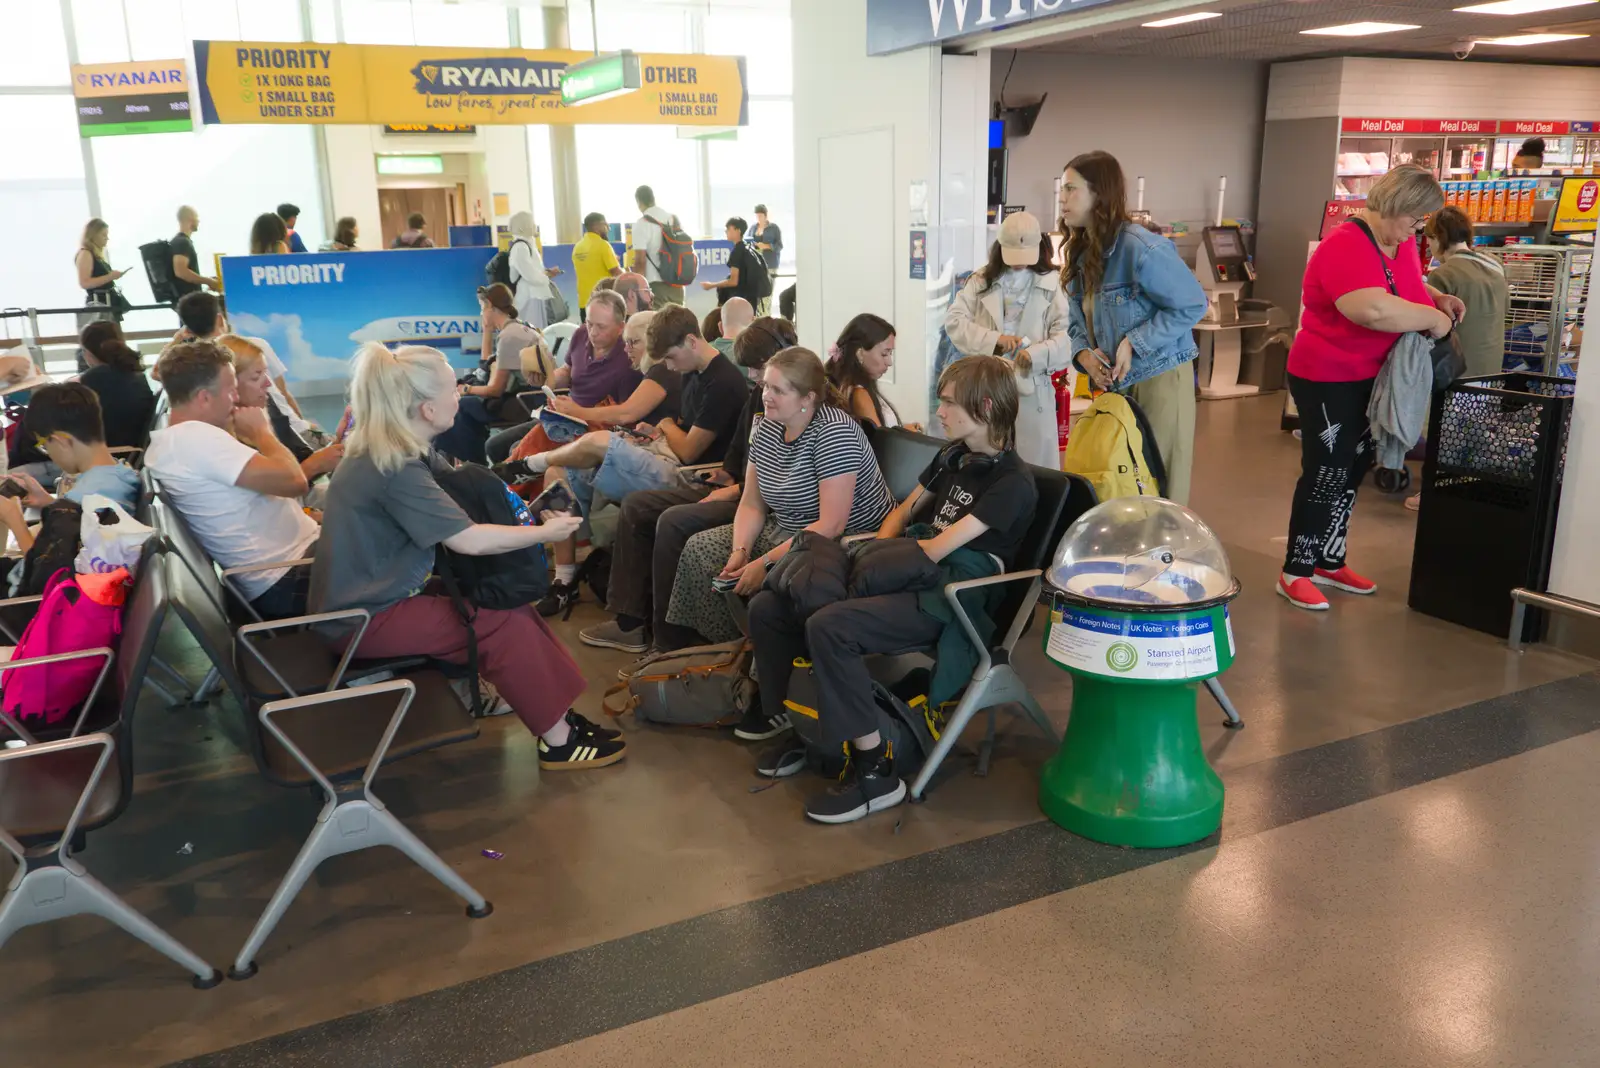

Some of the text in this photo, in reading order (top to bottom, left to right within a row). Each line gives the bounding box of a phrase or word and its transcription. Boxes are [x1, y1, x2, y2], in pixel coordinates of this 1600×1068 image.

[236, 48, 331, 69] PRIORITY
[91, 70, 182, 87] RYANAIR
[256, 75, 331, 88] 1X 10KG BAG
[645, 66, 697, 84] OTHER
[268, 92, 308, 103] SMALL
[312, 92, 335, 103] BAG
[425, 92, 452, 108] Low
[499, 94, 536, 115] great
[666, 92, 697, 104] SMALL
[699, 93, 719, 104] BAG
[260, 105, 336, 117] UNDER SEAT
[659, 105, 719, 116] UNDER SEAT
[1361, 119, 1404, 131] Meal Deal
[1440, 121, 1480, 132] Meal Deal
[1516, 122, 1554, 133] Meal Deal
[251, 263, 345, 286] PRIORITY
[1079, 616, 1101, 628] Foreign
[1102, 621, 1121, 630] Notes
[1142, 624, 1162, 633] Notes
[1171, 625, 1194, 633] Foreign
[1195, 622, 1209, 630] Coins
[1147, 645, 1211, 658] Stansted Airport
